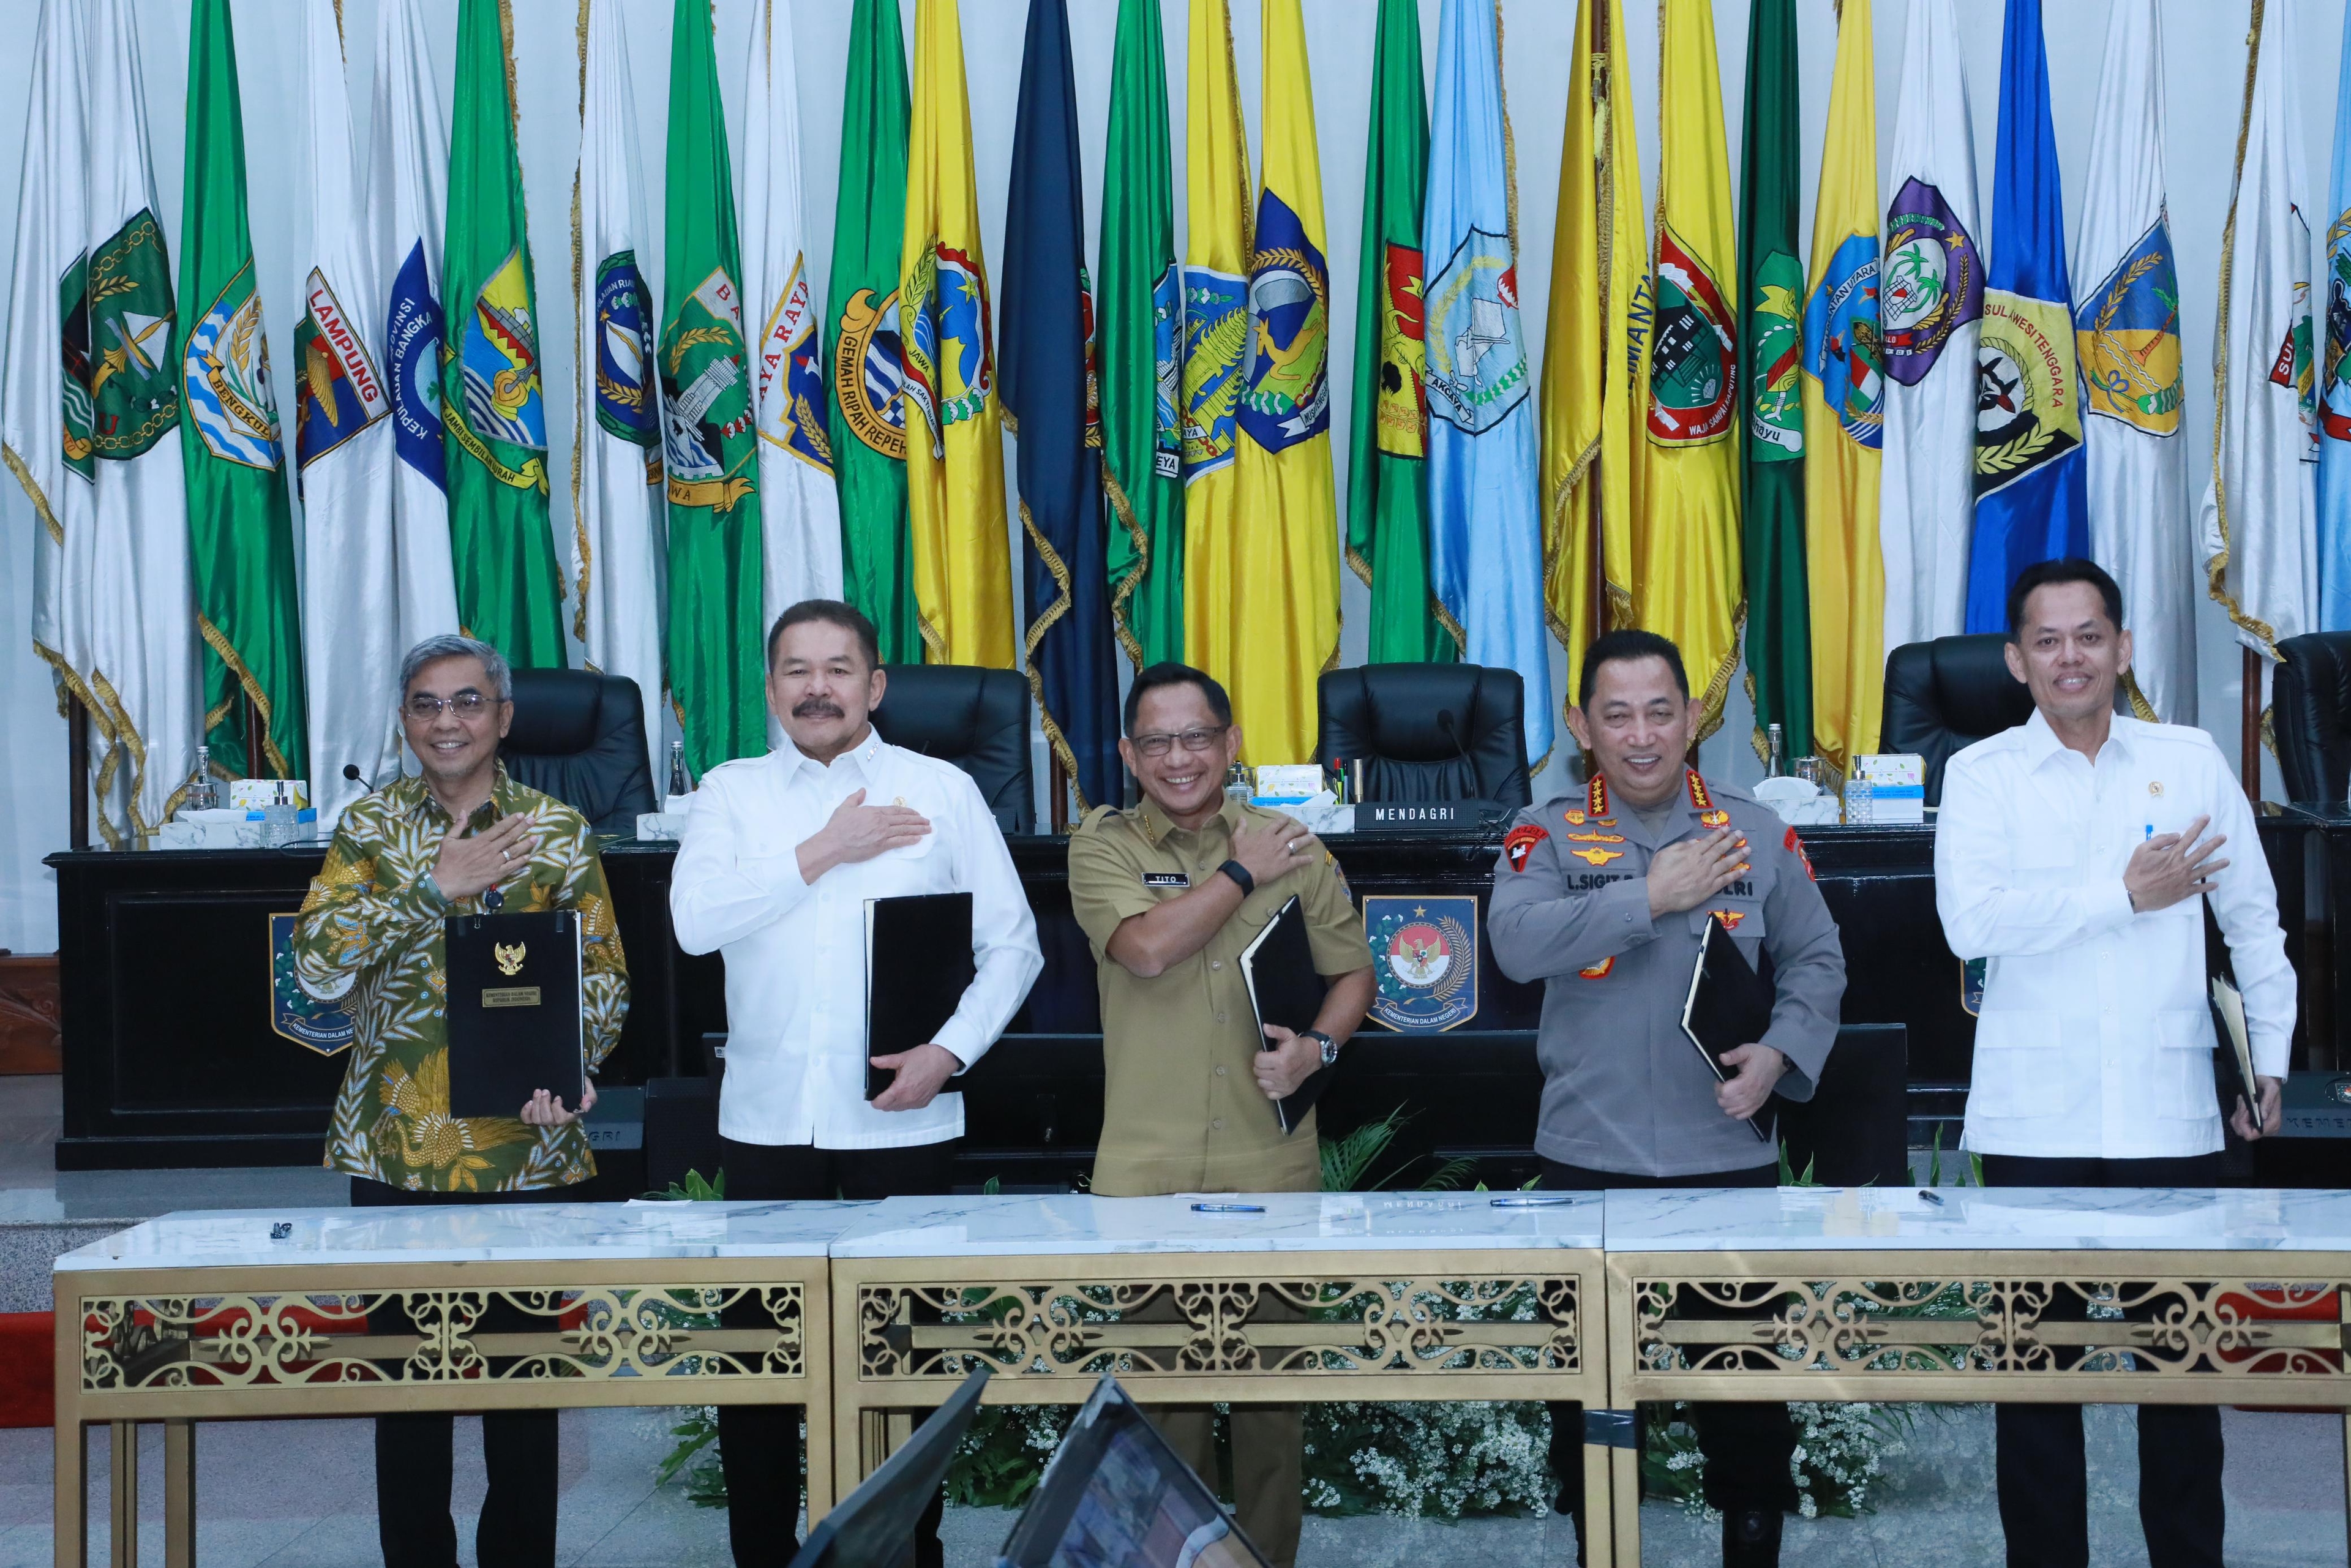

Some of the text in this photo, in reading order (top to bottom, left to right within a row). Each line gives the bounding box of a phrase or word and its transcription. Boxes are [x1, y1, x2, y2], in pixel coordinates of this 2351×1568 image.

[1847, 264, 1876, 290] UTARA
[773, 281, 809, 343] RAYA
[310, 289, 378, 403] LAMPUNG
[909, 350, 929, 373] JAWA
[1985, 304, 2064, 408] SULAWESI TENGGARA
[396, 311, 432, 440] KEPULAUAN BANGKA
[212, 379, 269, 436] BENGKUL
[841, 336, 907, 454] GEMAH RIPAH REPEH
[916, 388, 930, 410] SAKTI
[1432, 378, 1462, 412] AKCAYA
[1689, 422, 1709, 435] WAJA
[1709, 403, 1728, 428] SAMPAI
[444, 411, 463, 437] JAMBI
[461, 433, 493, 468] SEMBILAN
[1375, 807, 1454, 821] MENDAGRI
[1567, 874, 1620, 890] L.SIGIT
[293, 1022, 327, 1038] KEMENTERIAN
[1384, 1007, 1419, 1024] KEMENTERIAN
[1439, 1008, 1457, 1022] NEGERI
